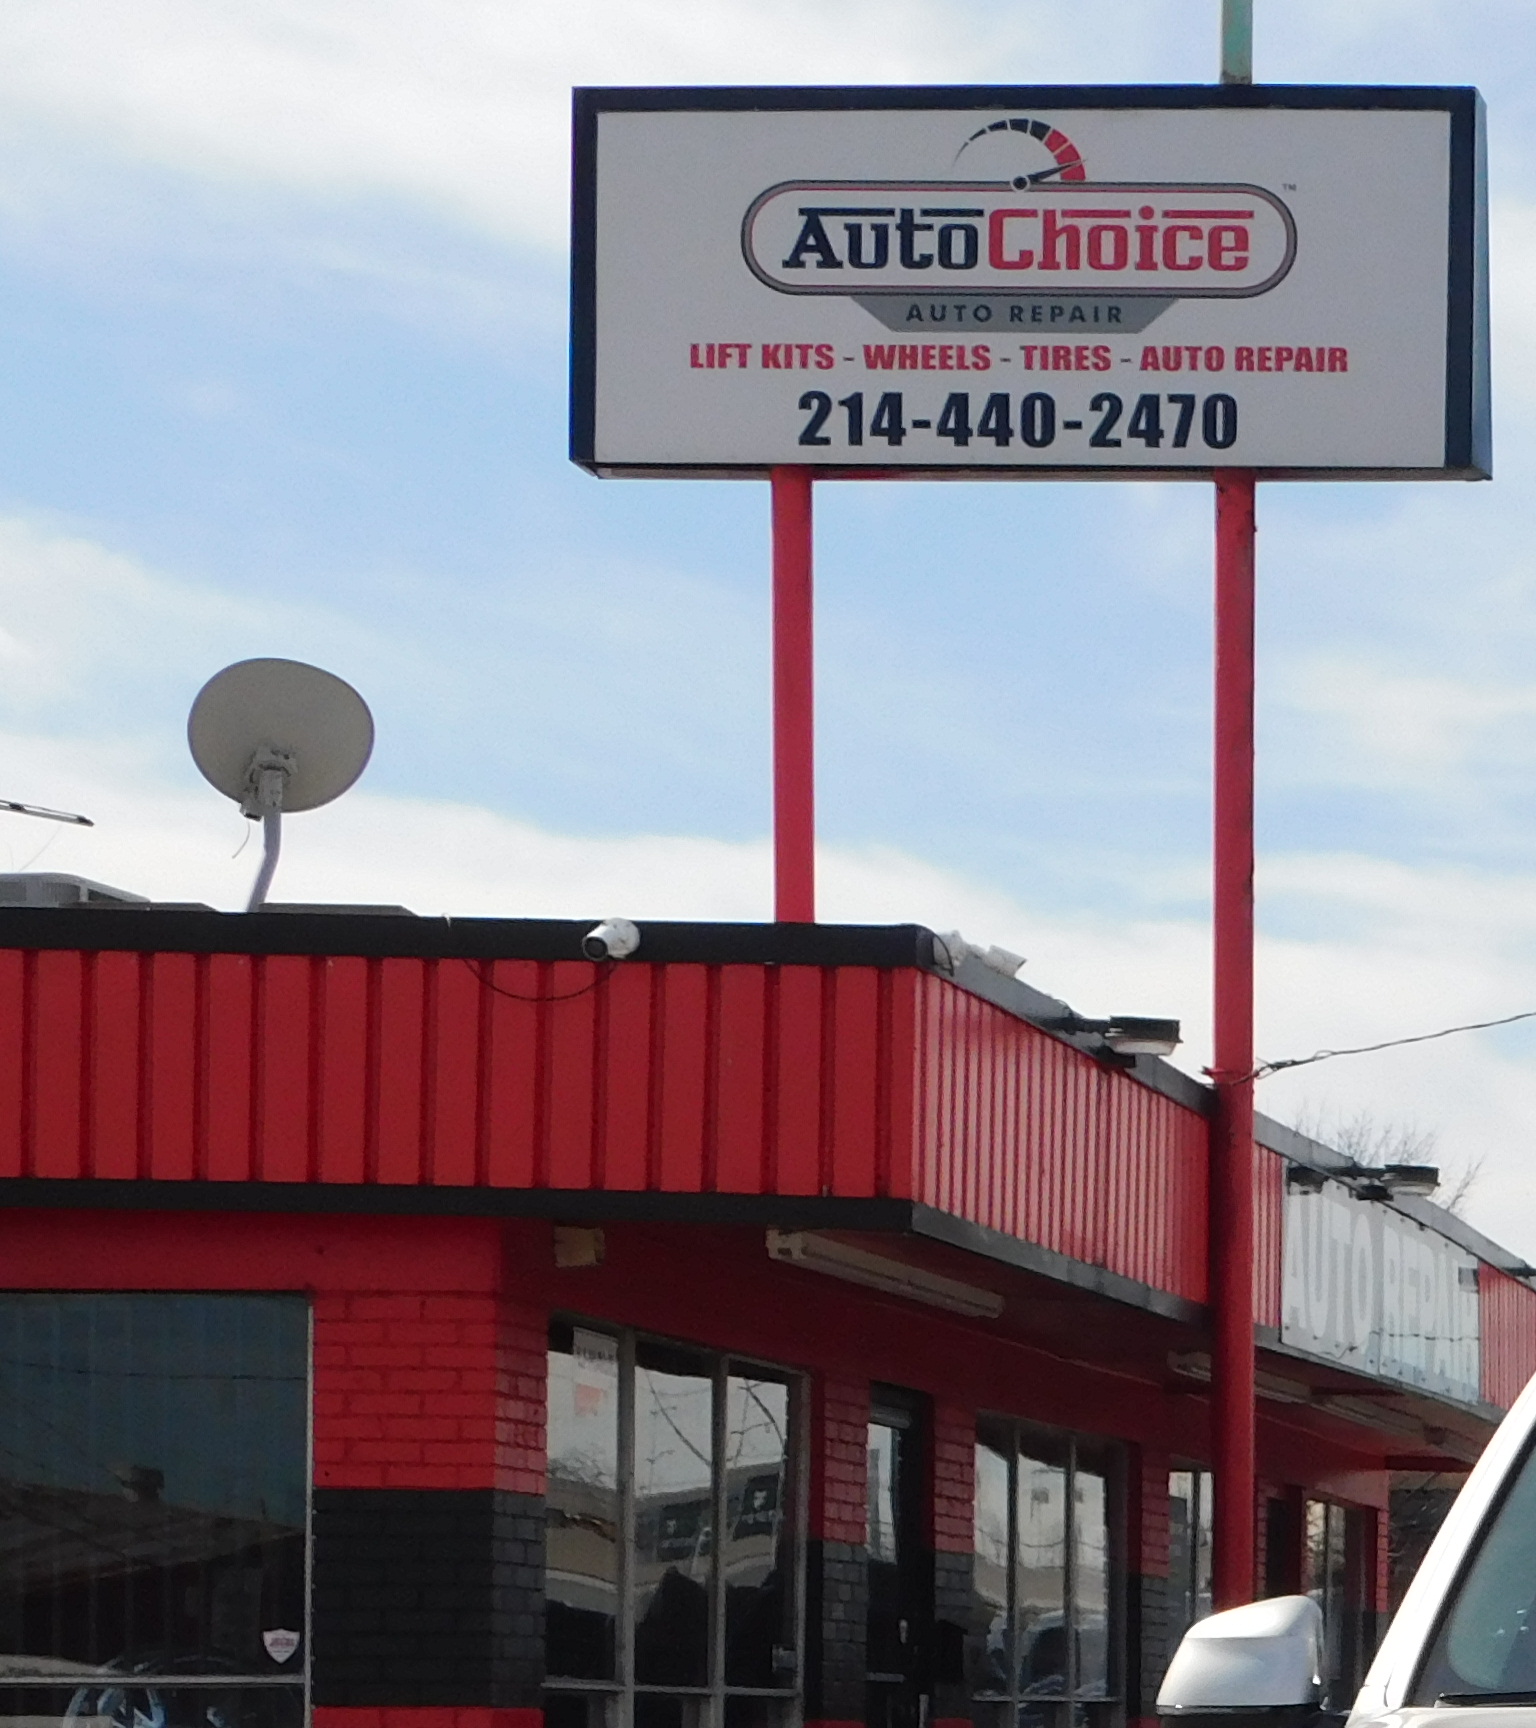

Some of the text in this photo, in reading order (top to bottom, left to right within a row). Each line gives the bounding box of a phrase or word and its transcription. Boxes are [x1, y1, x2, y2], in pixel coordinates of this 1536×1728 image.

[781, 207, 1254, 272] AutoChoice
[905, 303, 1122, 325] AUTO REPAIR
[689, 343, 753, 370] LIFT
[761, 343, 836, 371] KITS
[863, 344, 992, 372] WHEELS
[1023, 345, 1112, 372] TIRES
[1139, 345, 1226, 373] AUTO
[1234, 346, 1349, 373] REPAIR
[798, 390, 1239, 450] 214-440-2470
[1285, 1193, 1374, 1354] AUTO
